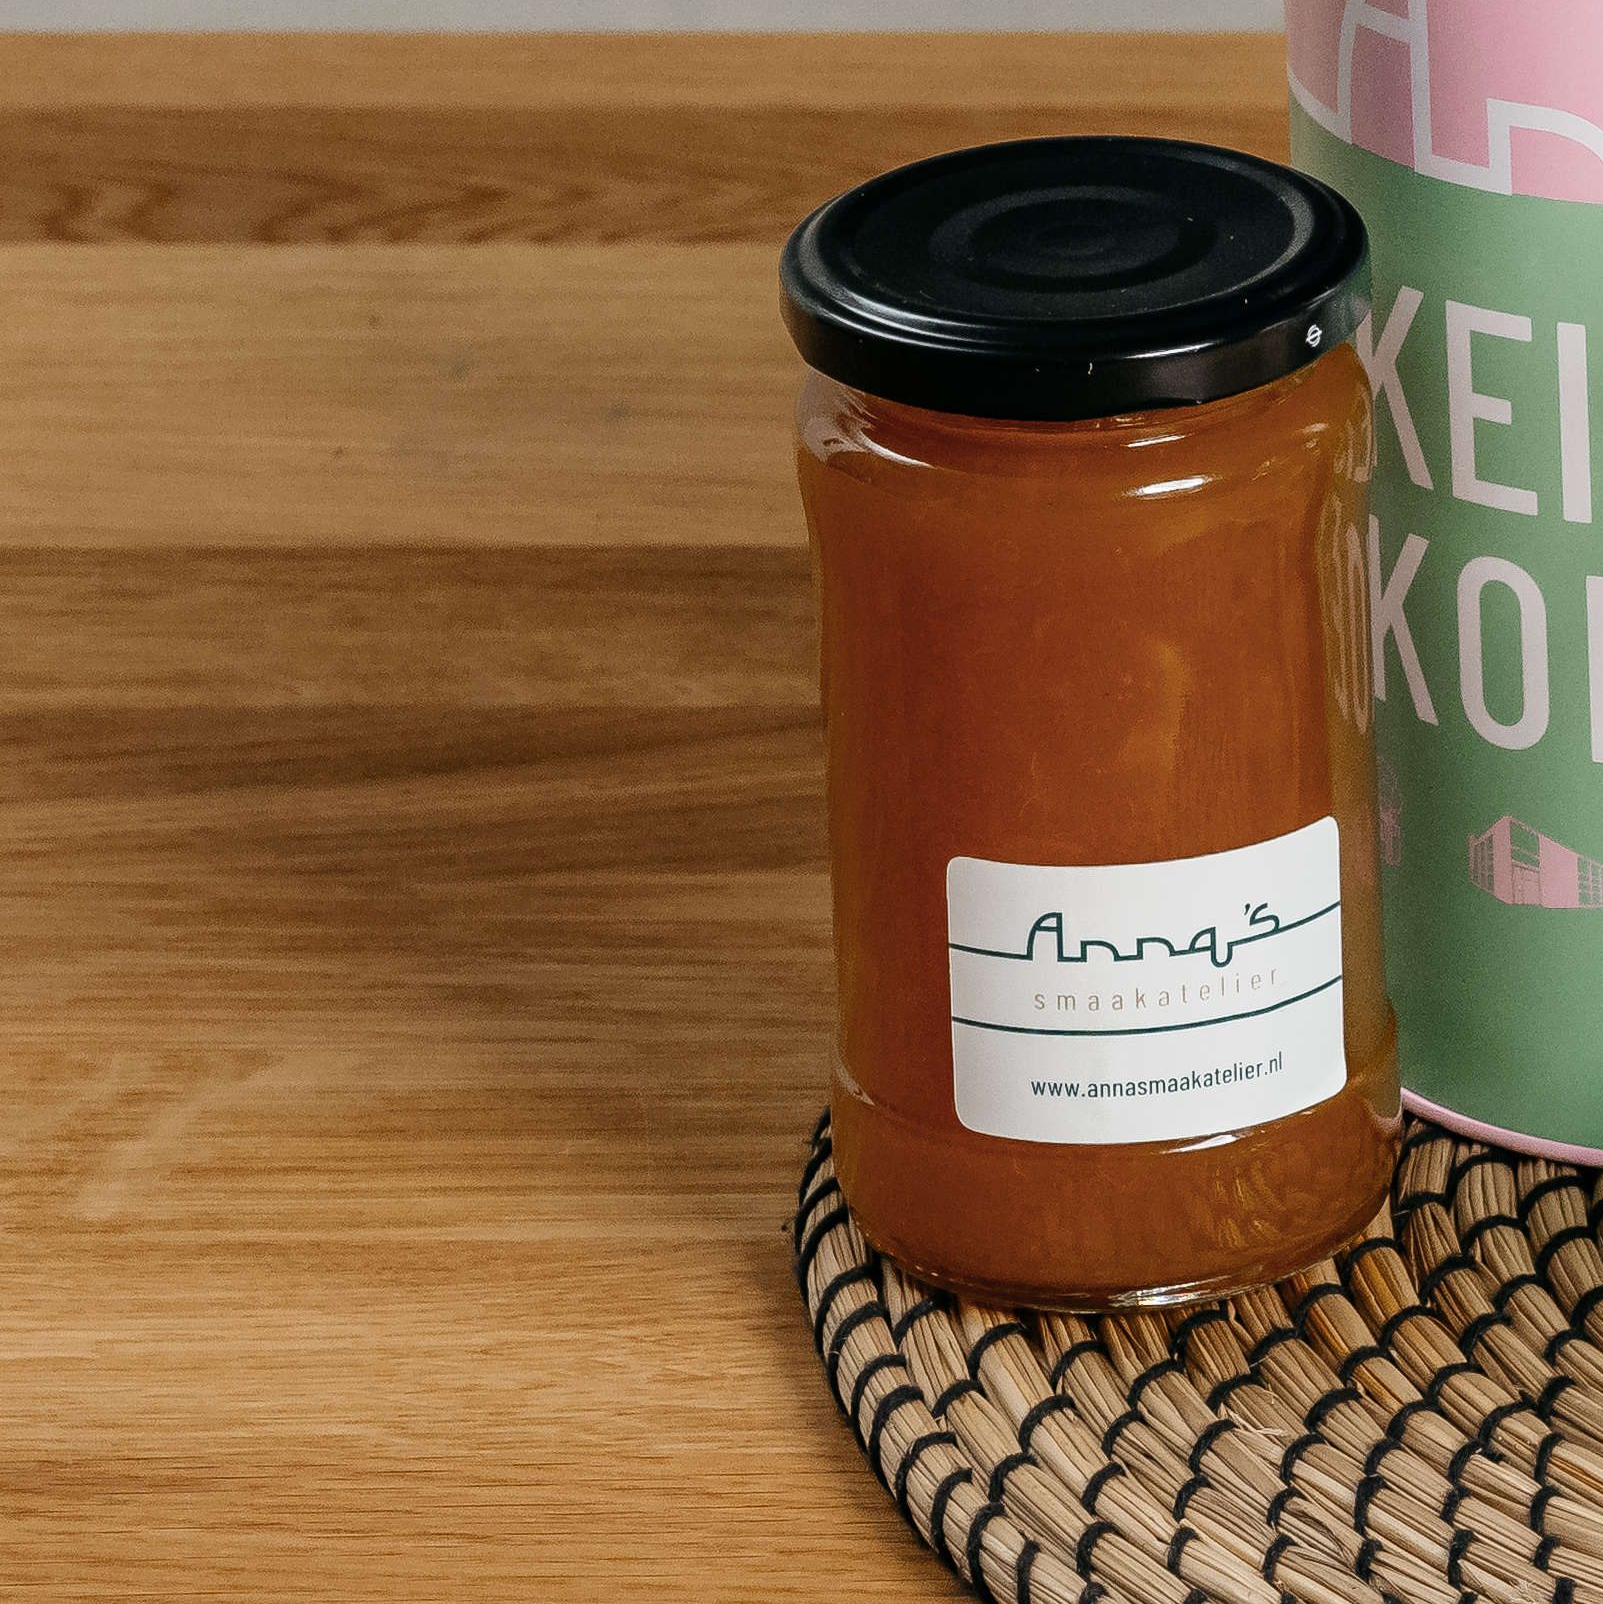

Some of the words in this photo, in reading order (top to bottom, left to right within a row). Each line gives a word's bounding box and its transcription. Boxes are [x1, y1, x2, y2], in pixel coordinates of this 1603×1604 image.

[1027, 902, 1281, 968] Anna's
[1034, 968, 1277, 1011] smaakatelier
[1031, 1051, 1284, 1098] www.annasmaakatelier.nl
